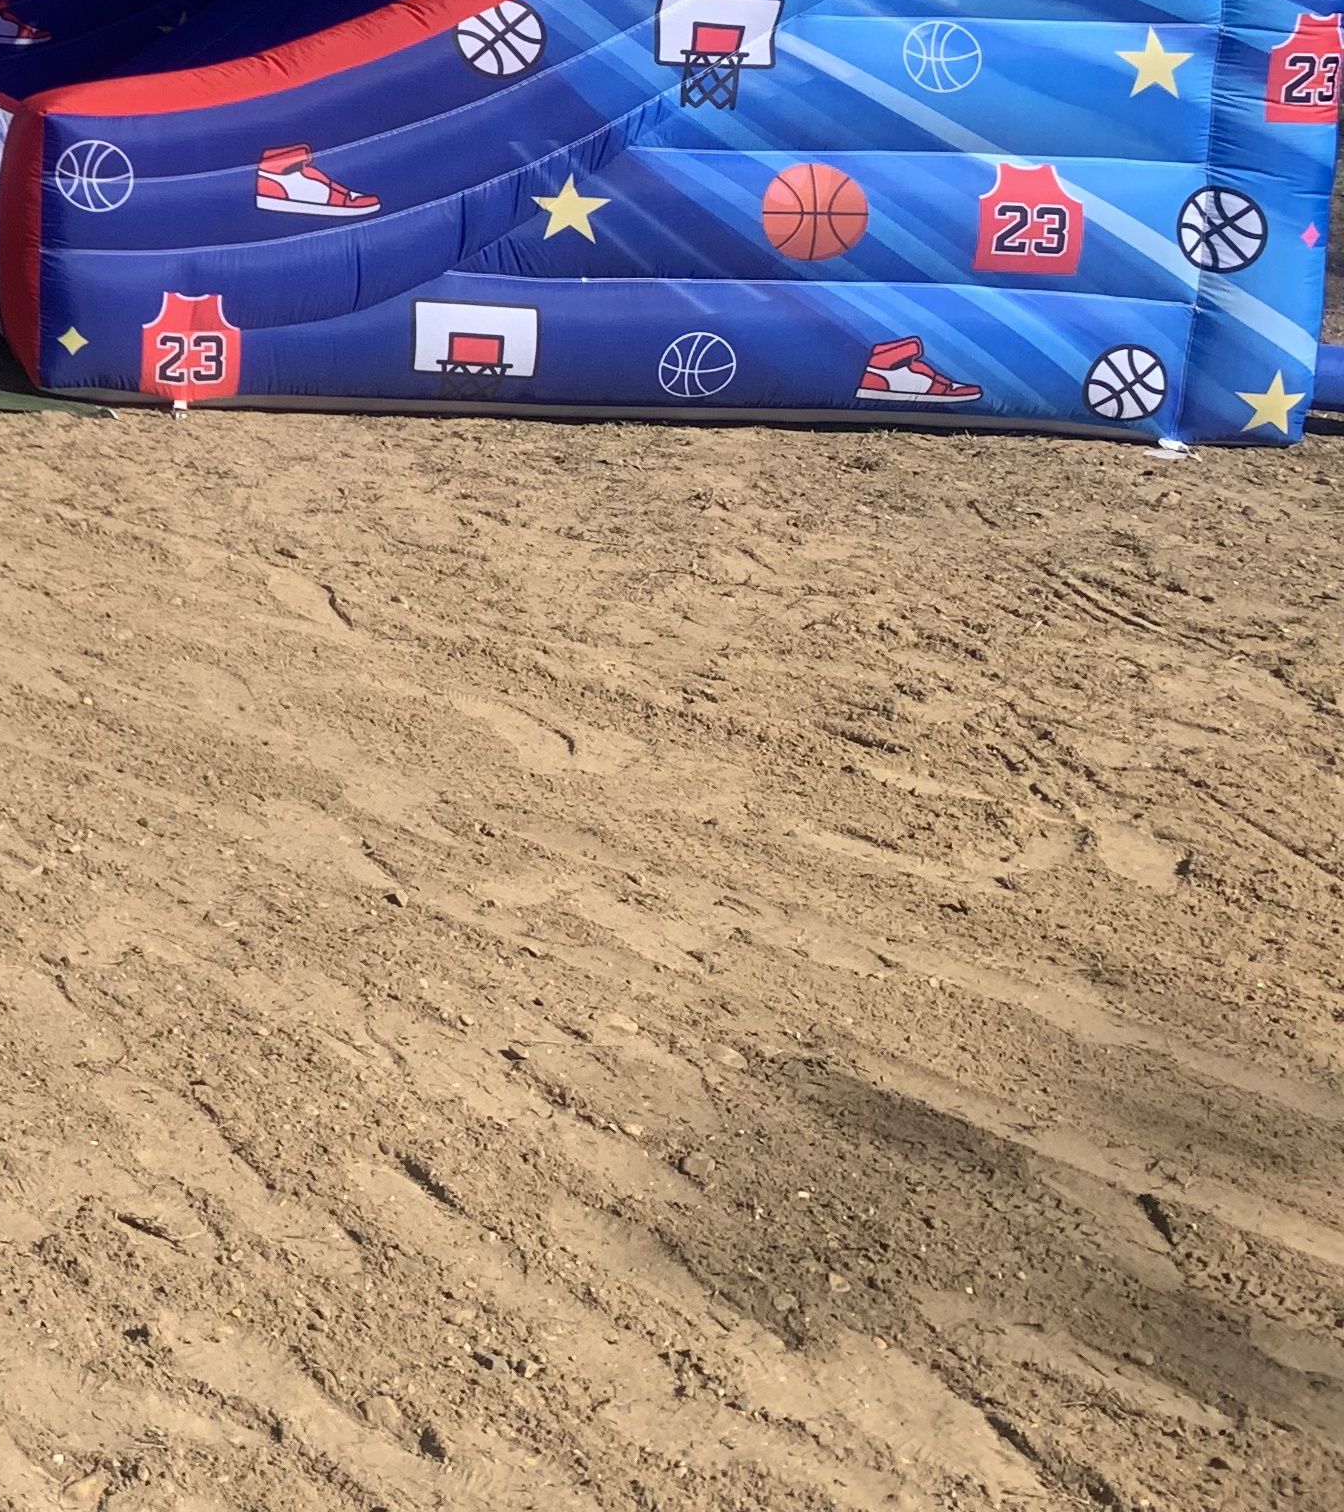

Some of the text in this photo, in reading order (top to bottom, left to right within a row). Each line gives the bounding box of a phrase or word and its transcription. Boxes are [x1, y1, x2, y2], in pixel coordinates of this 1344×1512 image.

[1280, 52, 1341, 106] 23
[990, 202, 1071, 256] 23
[155, 331, 228, 386] 23
